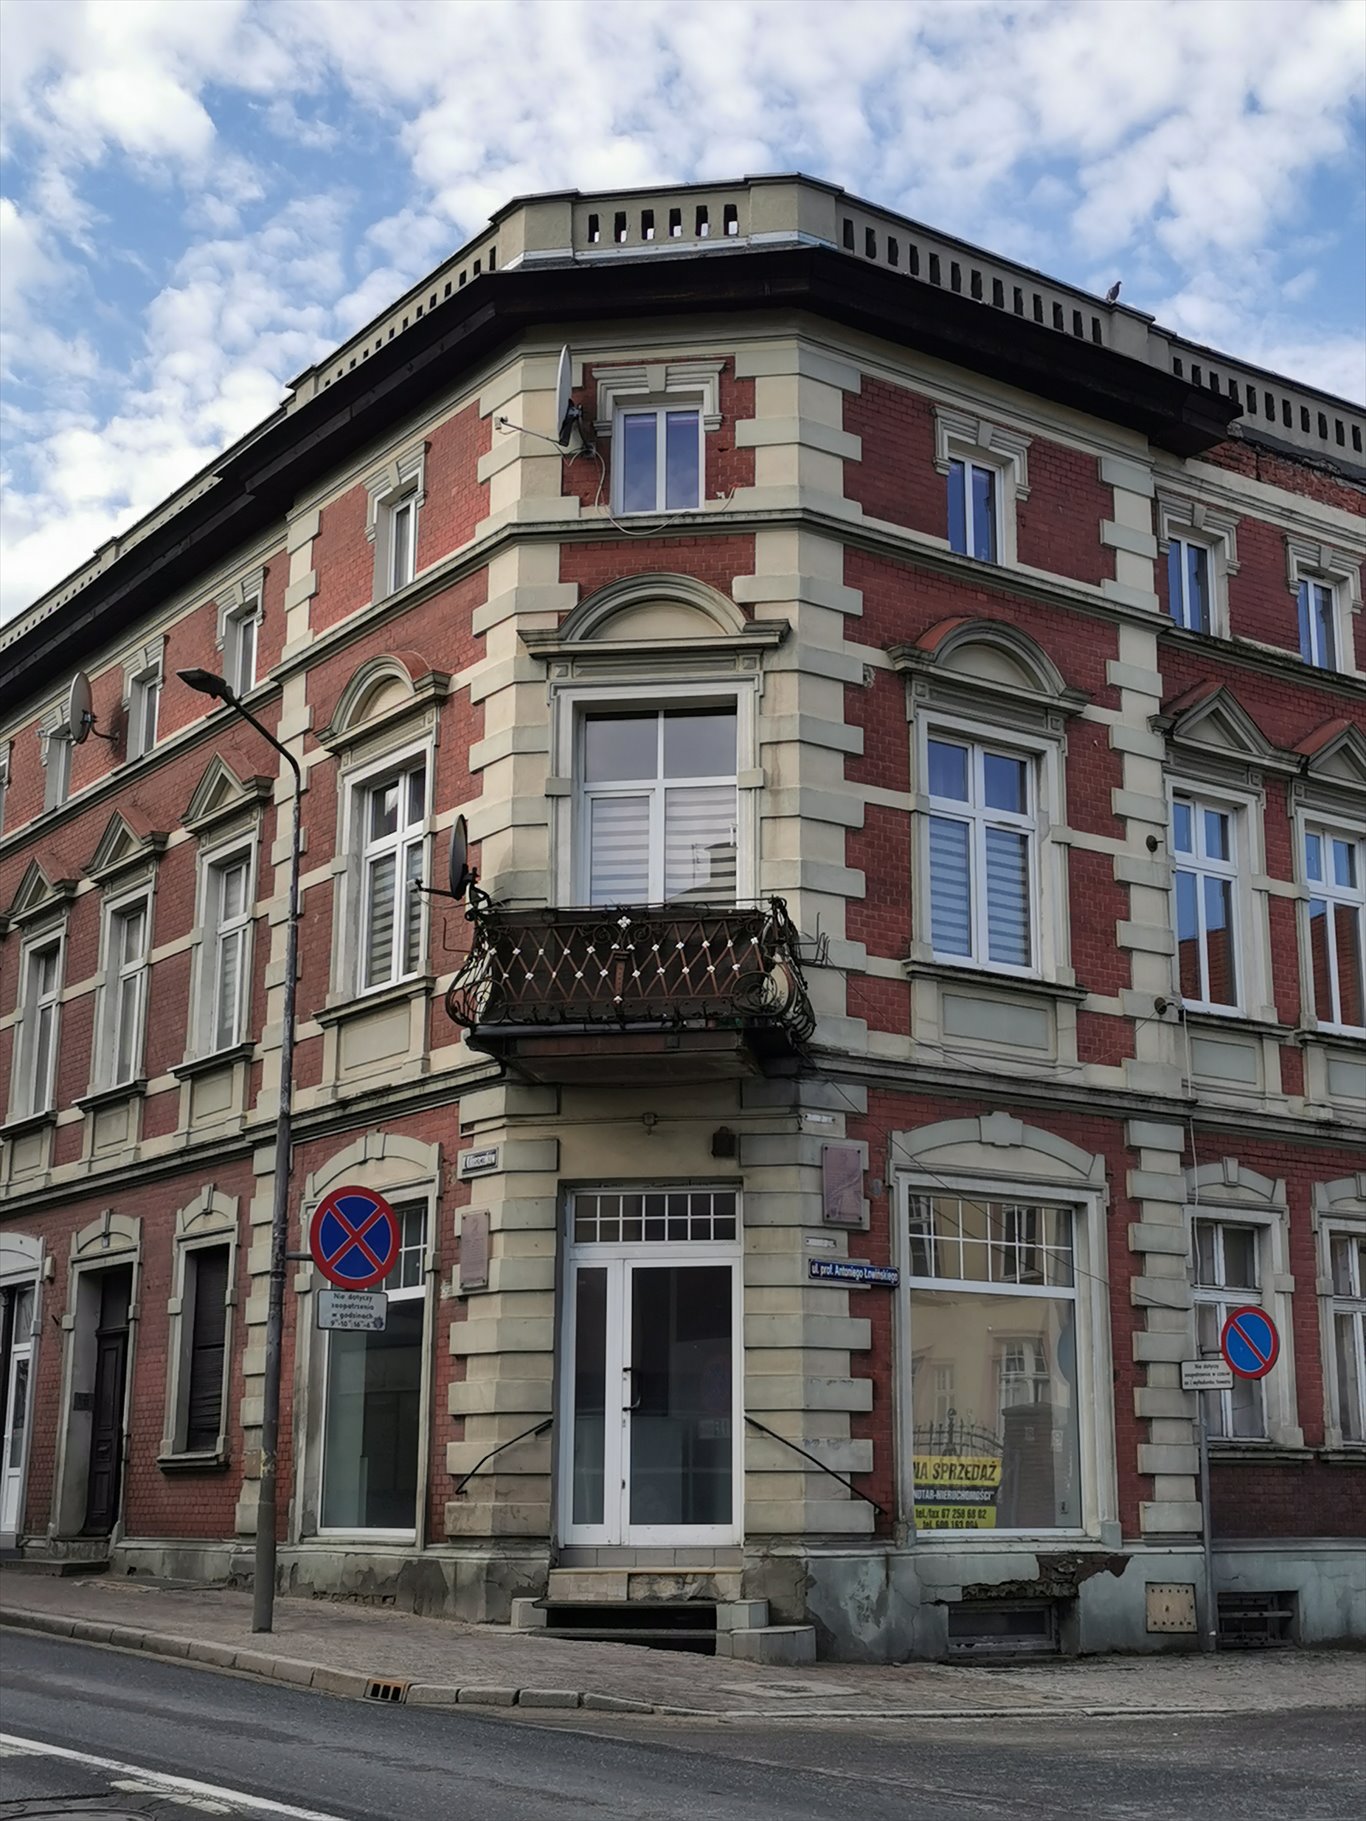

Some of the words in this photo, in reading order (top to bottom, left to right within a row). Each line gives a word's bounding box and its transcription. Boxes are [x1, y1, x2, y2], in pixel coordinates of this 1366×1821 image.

[820, 1264, 834, 1277] prof.
[835, 1265, 864, 1281] Antoniego
[348, 1294, 373, 1303] dotyczy
[913, 1461, 928, 1480] NA
[932, 1461, 998, 1481] SPRZEDAŻ
[941, 1508, 950, 1519] 67
